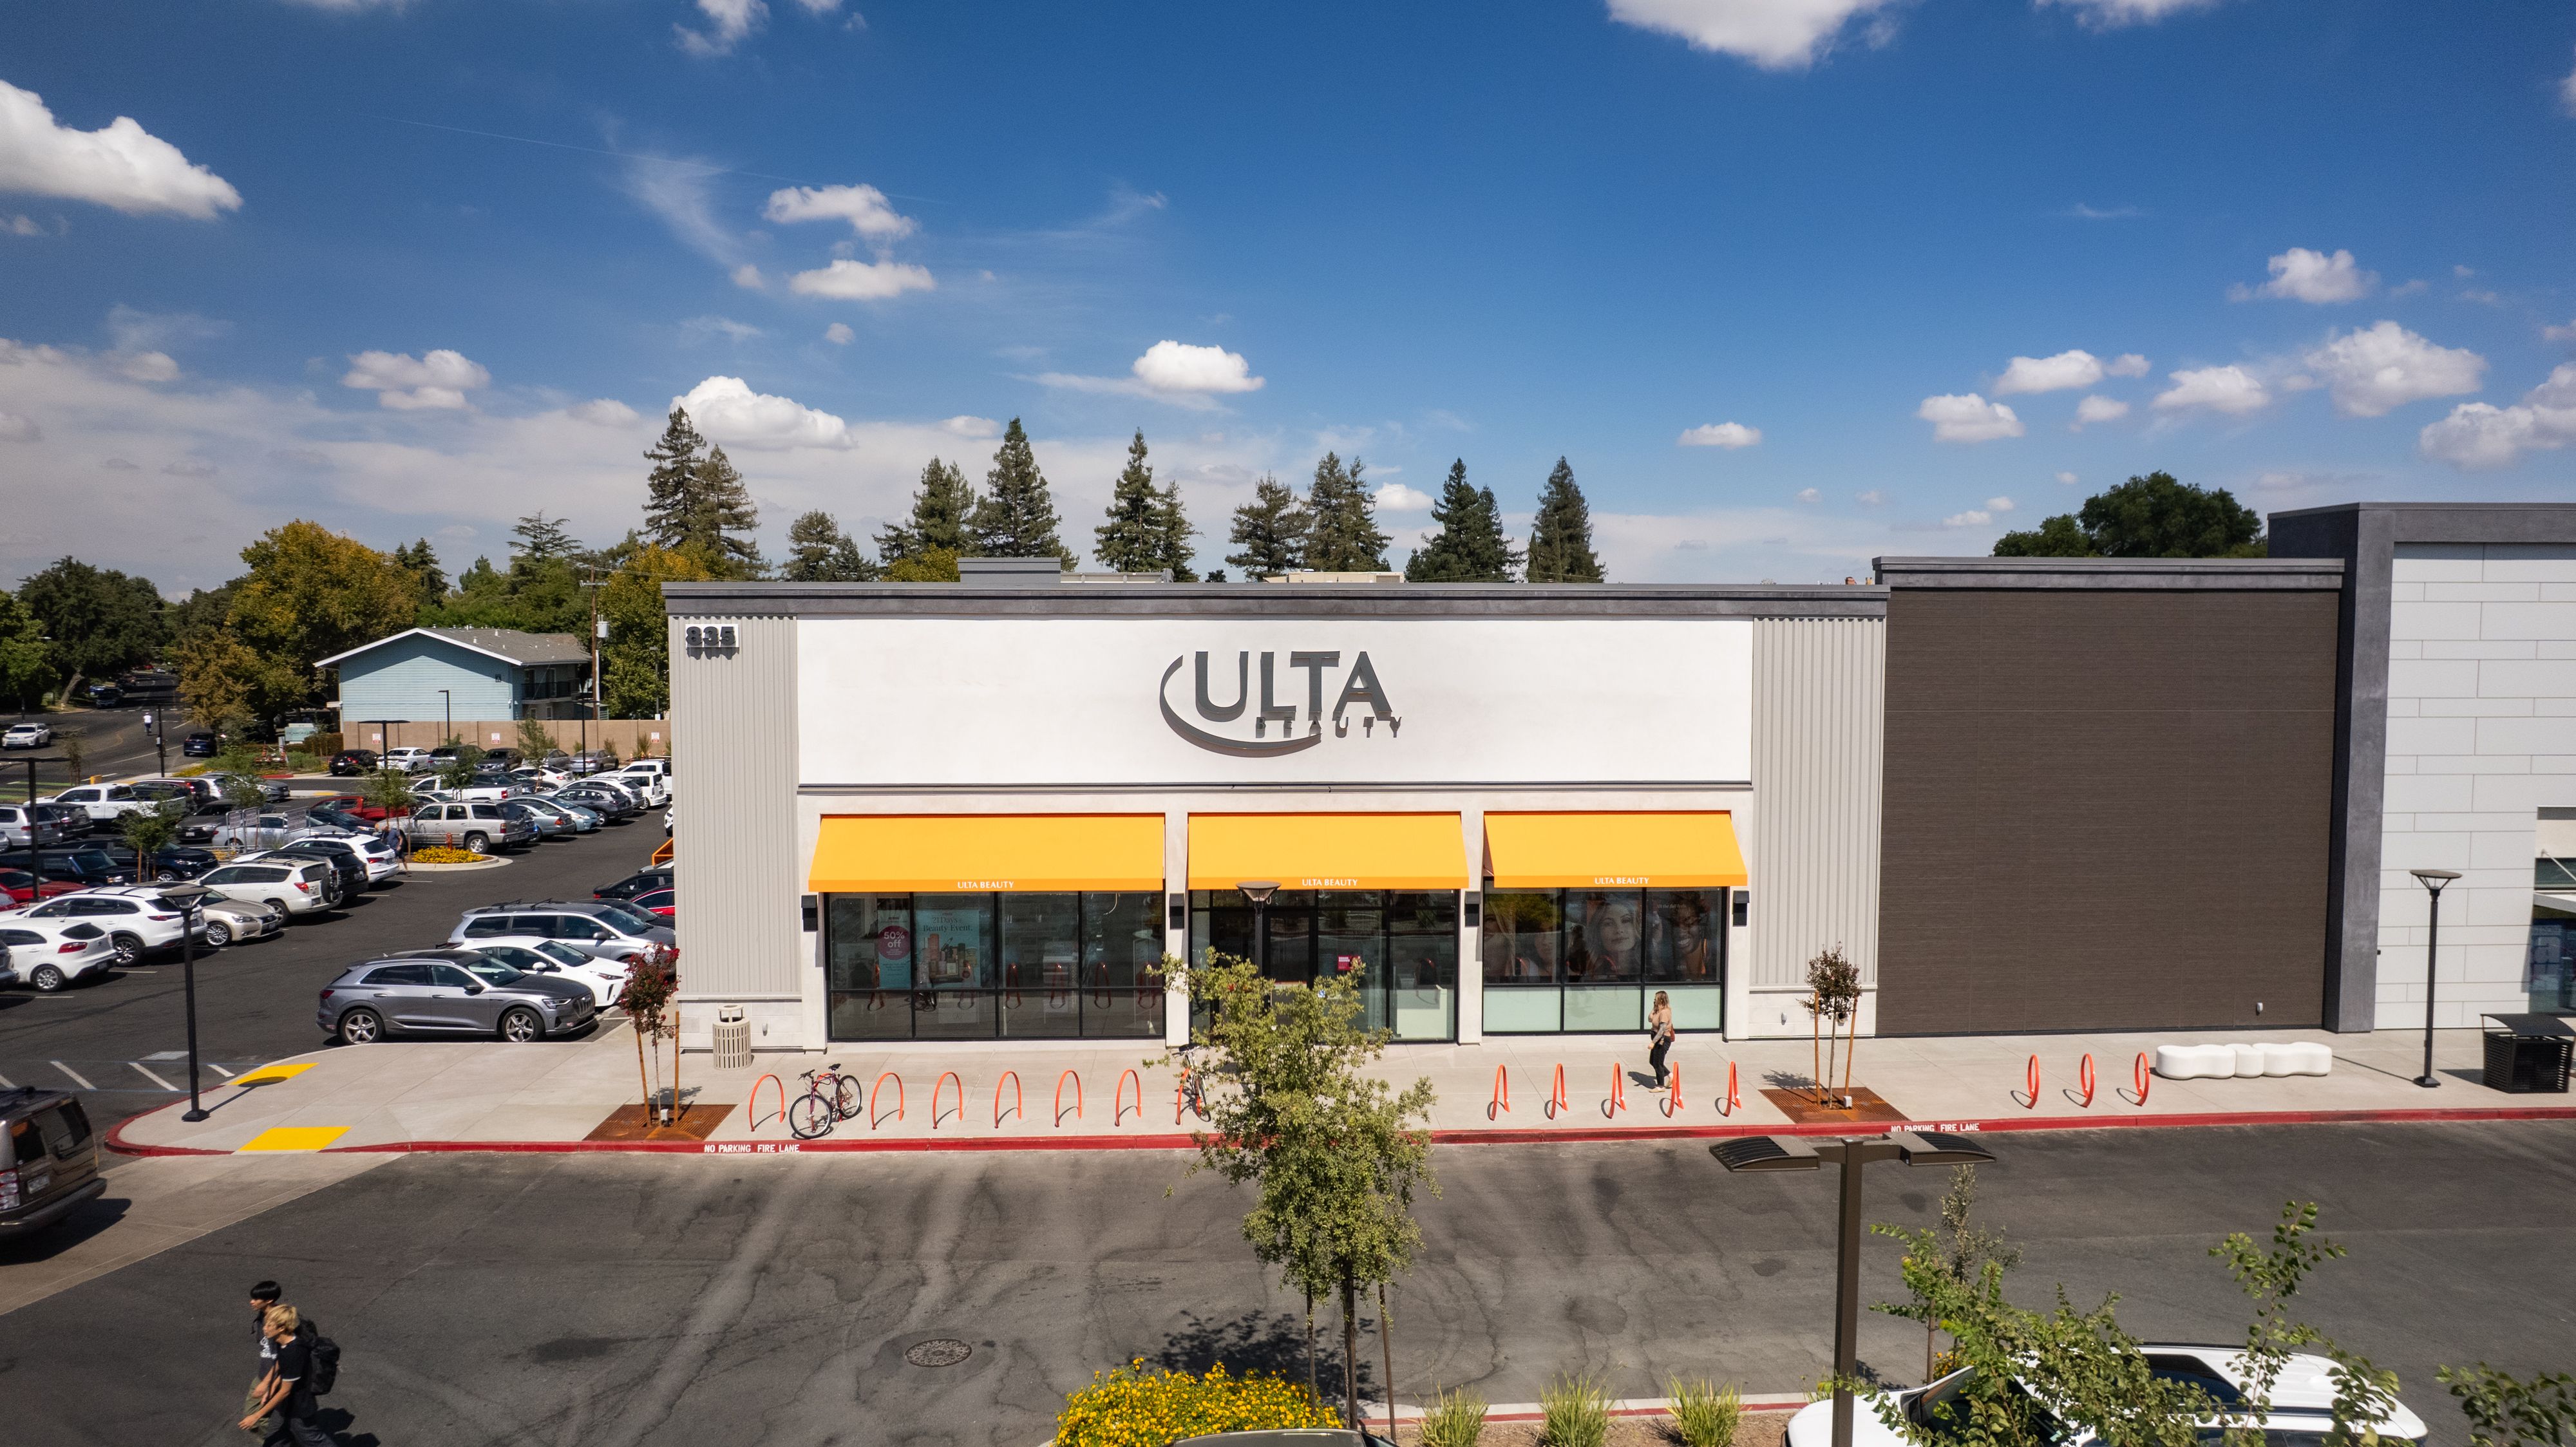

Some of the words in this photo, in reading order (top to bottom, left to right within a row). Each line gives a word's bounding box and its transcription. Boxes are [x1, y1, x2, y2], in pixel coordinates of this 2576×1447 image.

[686, 626, 735, 646] 835
[1195, 650, 1393, 715] ULTA
[1256, 715, 1402, 732] BEAUTY
[884, 931, 905, 940] 50%
[887, 939, 902, 948] off
[1940, 1124, 1958, 1132] FIRE
[1960, 1123, 1980, 1131] LANE
[704, 1144, 715, 1153] NO
[719, 1144, 752, 1153] PARKING
[757, 1144, 776, 1153] FIRE
[779, 1144, 800, 1153] LANE
